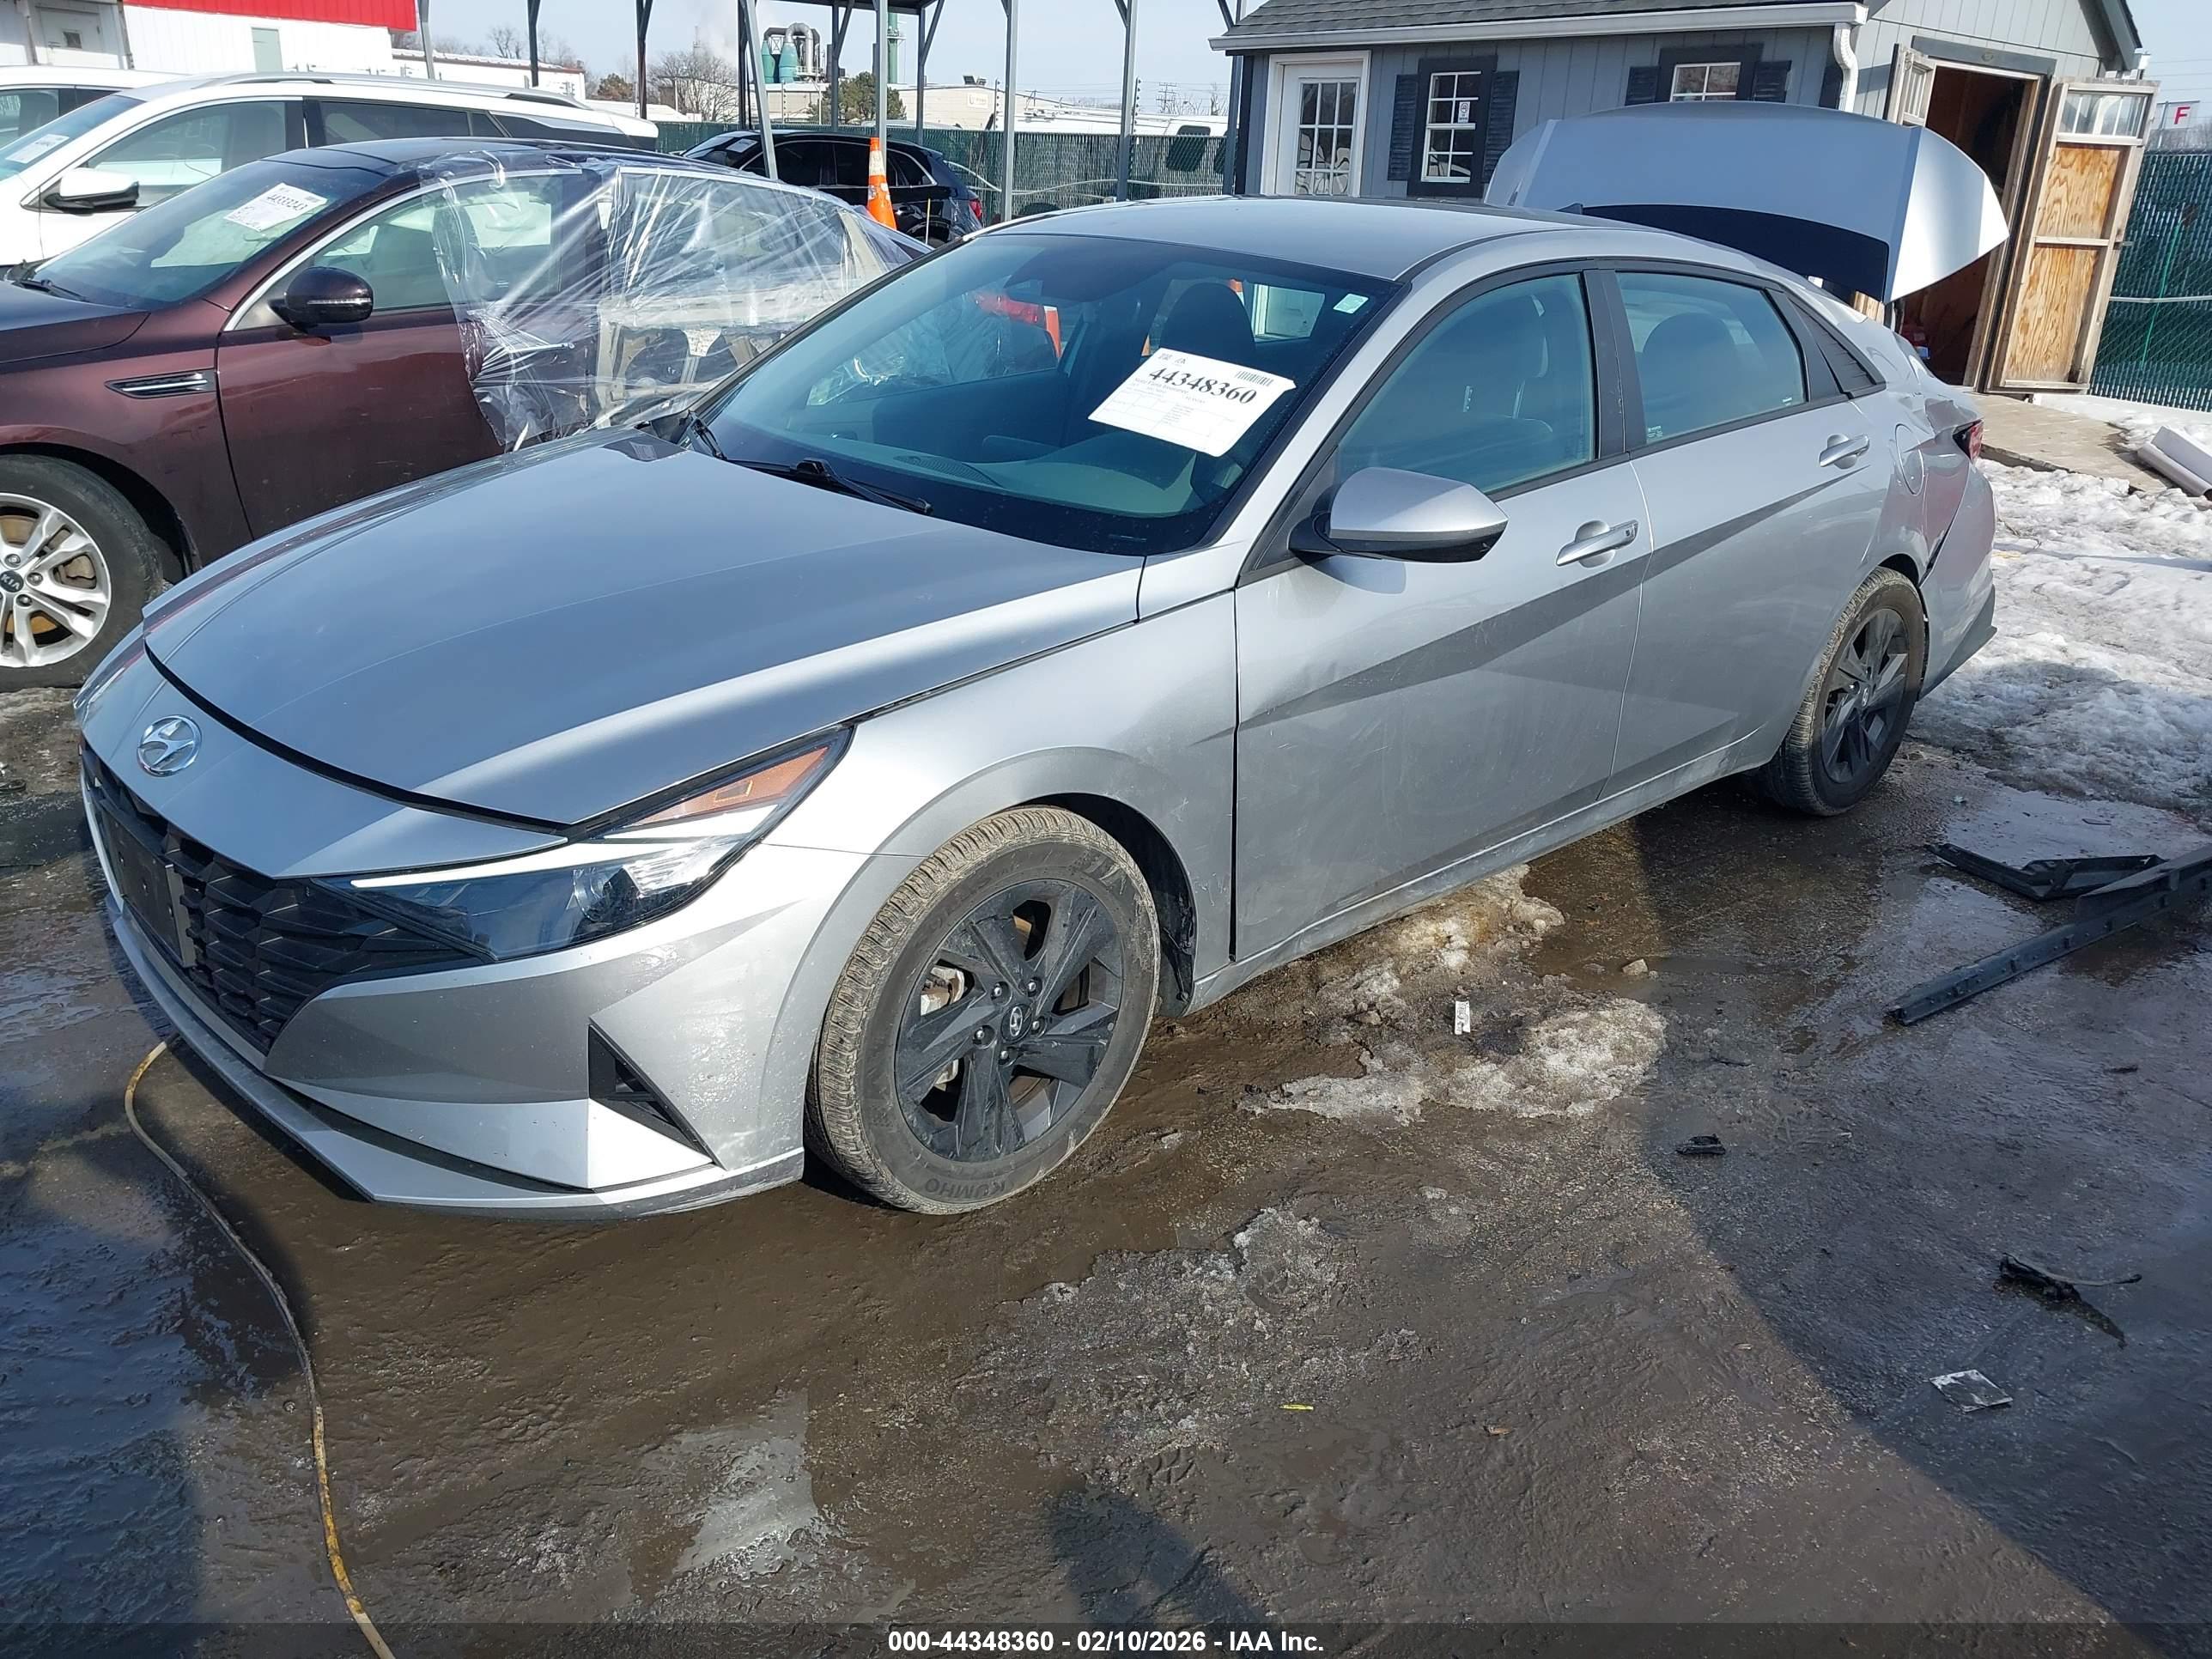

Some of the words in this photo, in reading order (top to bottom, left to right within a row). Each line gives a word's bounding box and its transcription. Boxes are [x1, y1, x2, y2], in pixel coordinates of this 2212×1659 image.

[2173, 106, 2191, 125] F
[1149, 368, 1258, 404] 44348360
[1, 574, 21, 590] KIA
[925, 1177, 1006, 1199] KUMHO
